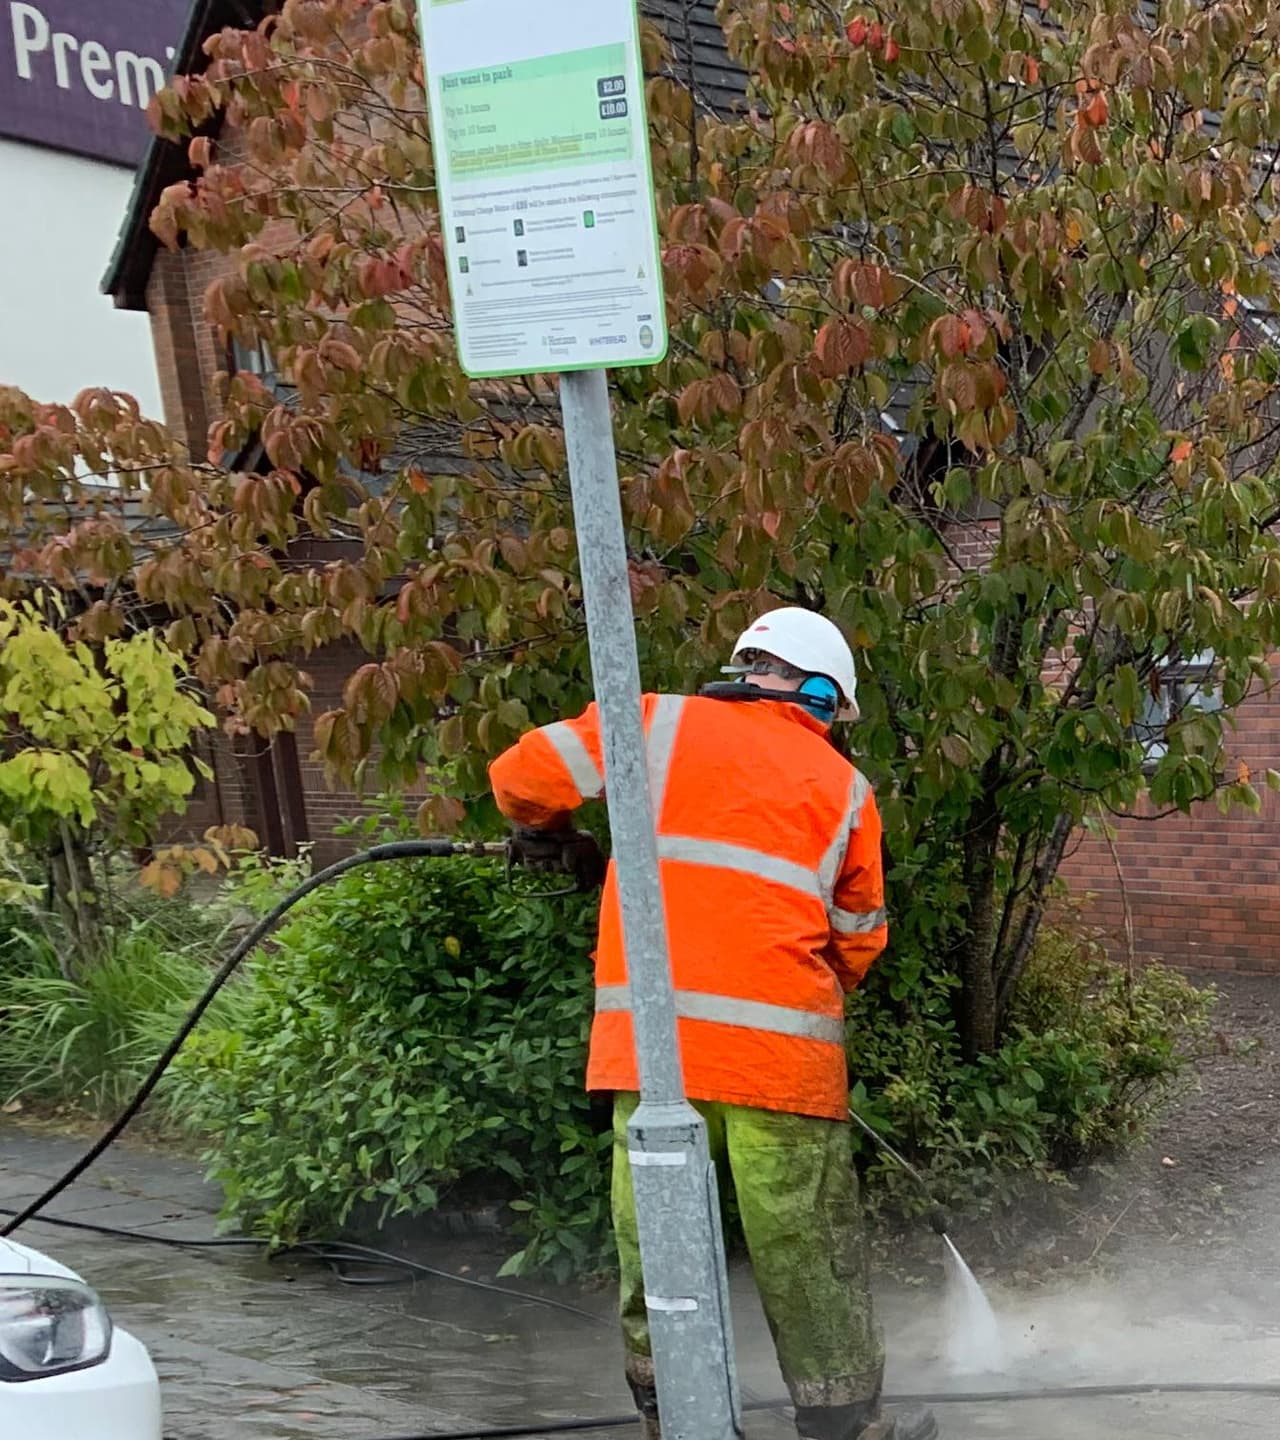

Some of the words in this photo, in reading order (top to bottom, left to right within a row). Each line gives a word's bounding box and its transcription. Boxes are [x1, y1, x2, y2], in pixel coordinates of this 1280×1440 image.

[10, 2, 175, 110] Prem
[442, 77, 458, 91] Just
[460, 74, 480, 85] want
[482, 72, 490, 82] to
[493, 66, 512, 84] park
[603, 80, 624, 93] £2.00
[602, 101, 625, 116] £10.00
